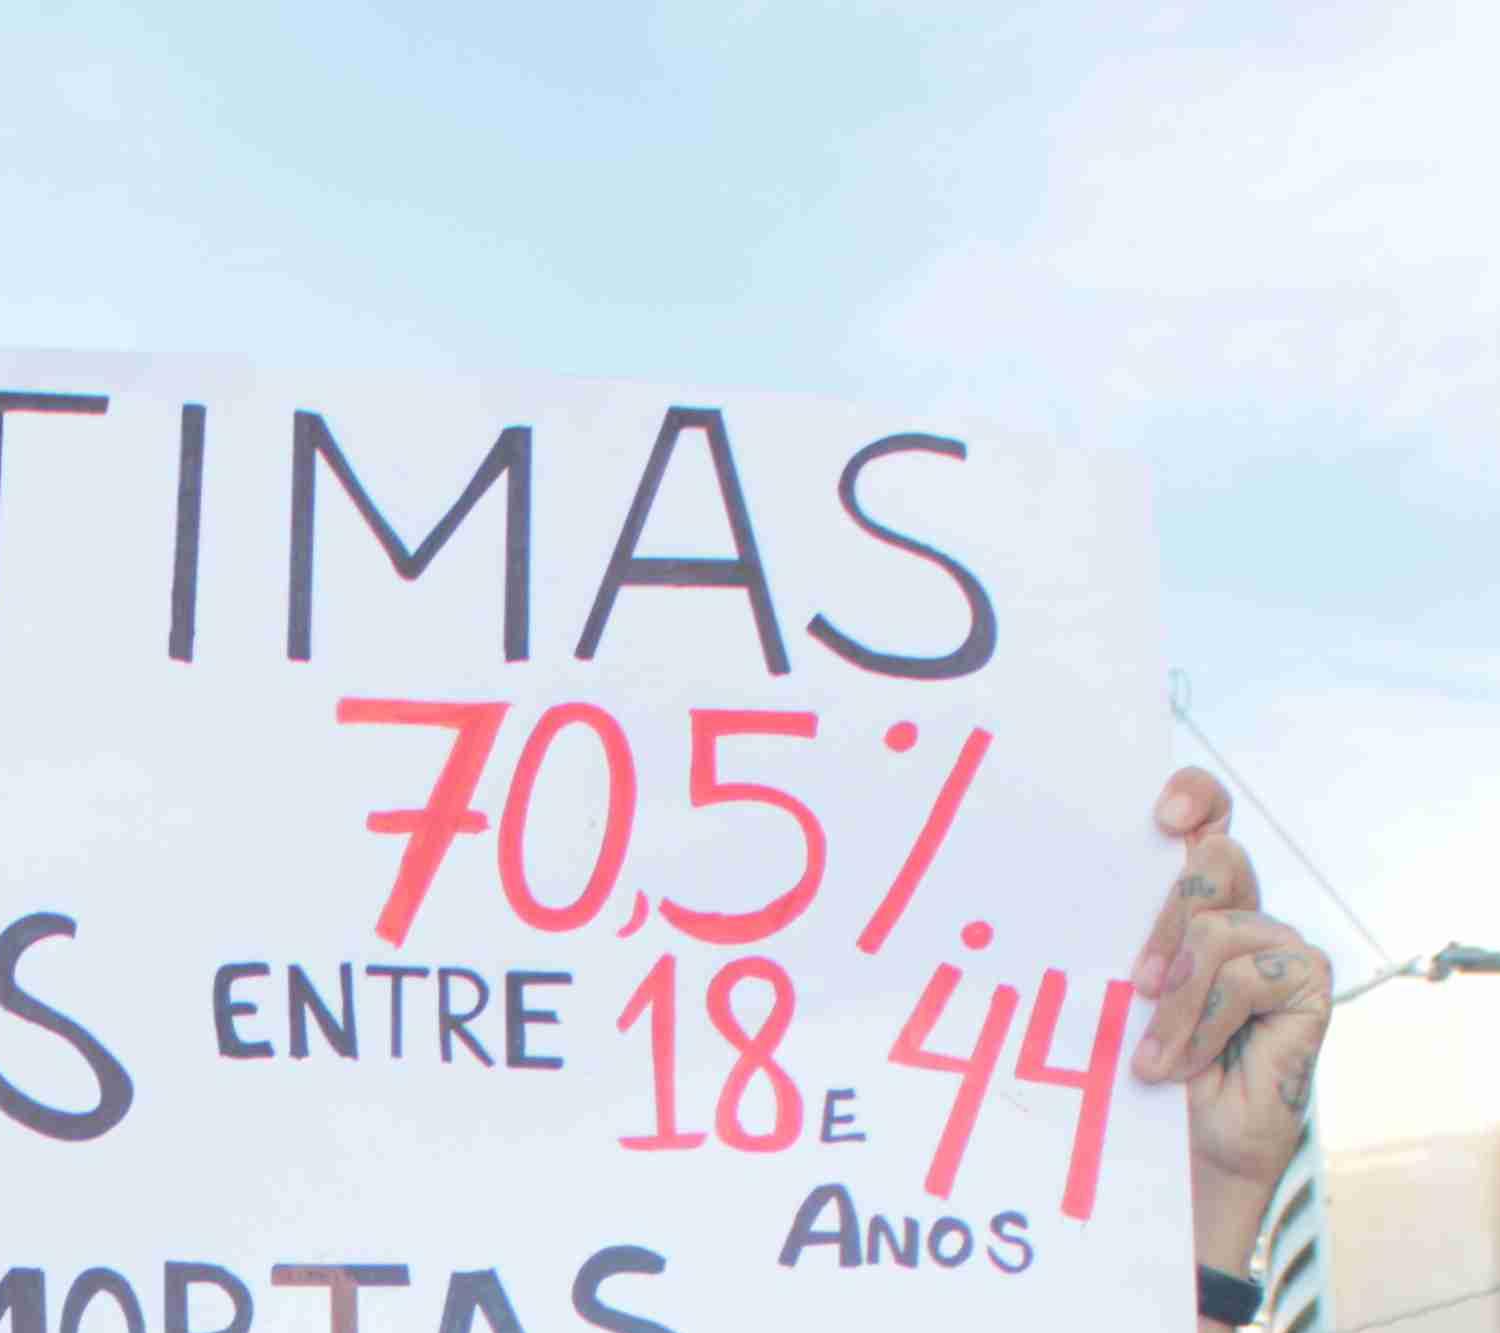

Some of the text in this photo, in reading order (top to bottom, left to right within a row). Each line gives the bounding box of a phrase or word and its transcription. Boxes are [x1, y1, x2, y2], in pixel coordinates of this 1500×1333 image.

[336, 696, 993, 956] 70,5%
[213, 953, 1136, 1221] ENTRE 18 E 44
